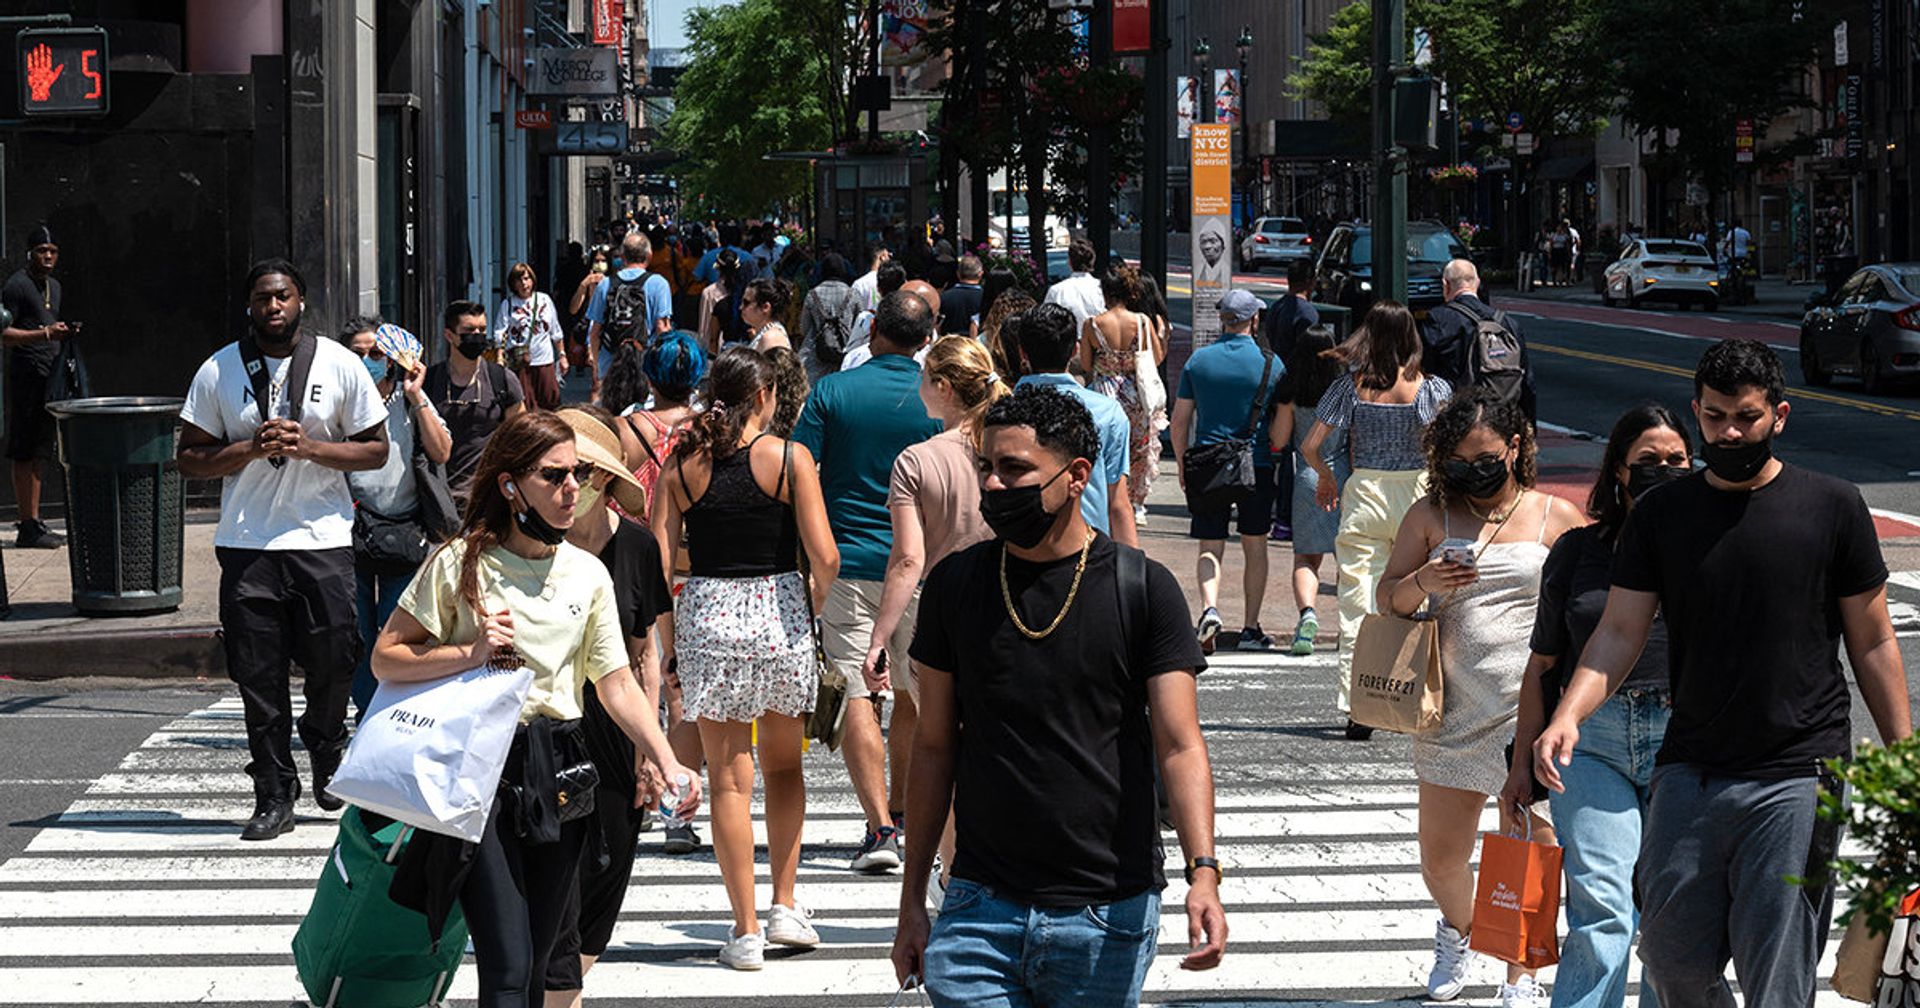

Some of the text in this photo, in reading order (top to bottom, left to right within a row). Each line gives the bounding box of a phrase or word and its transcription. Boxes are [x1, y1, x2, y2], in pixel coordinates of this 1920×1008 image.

[81, 50, 102, 99] 5
[547, 69, 608, 85] COLLEGE
[521, 112, 547, 122] ULTA
[562, 127, 620, 149] 45
[1195, 127, 1228, 137] know
[1195, 138, 1228, 149] NYC
[1358, 674, 1415, 695] FOREVER 21
